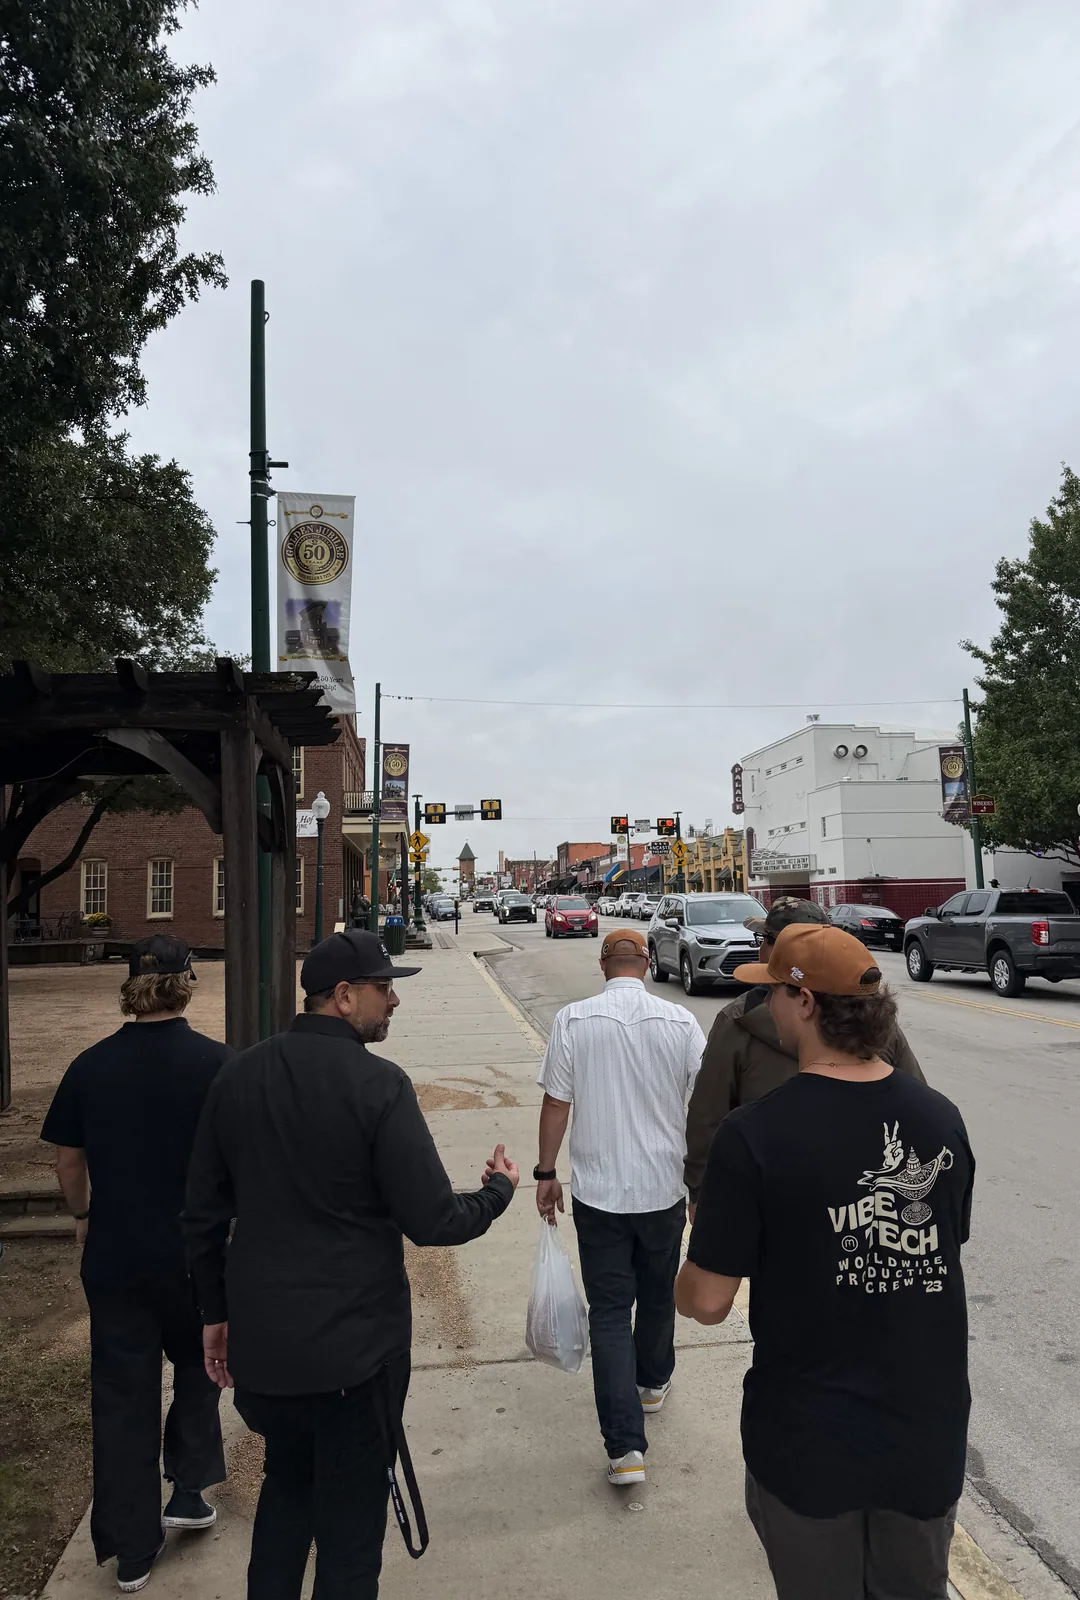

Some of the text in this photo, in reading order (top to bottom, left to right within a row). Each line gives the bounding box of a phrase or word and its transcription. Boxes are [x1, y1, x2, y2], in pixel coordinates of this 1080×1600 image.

[286, 525, 344, 558] GOLDEN JUBILEE
[304, 544, 325, 560] 50
[734, 767, 743, 810] PALACE
[298, 814, 315, 826] Hof
[828, 1192, 898, 1232] VIBE
[865, 1220, 938, 1255] TECH
[866, 1278, 914, 1294] CREW
